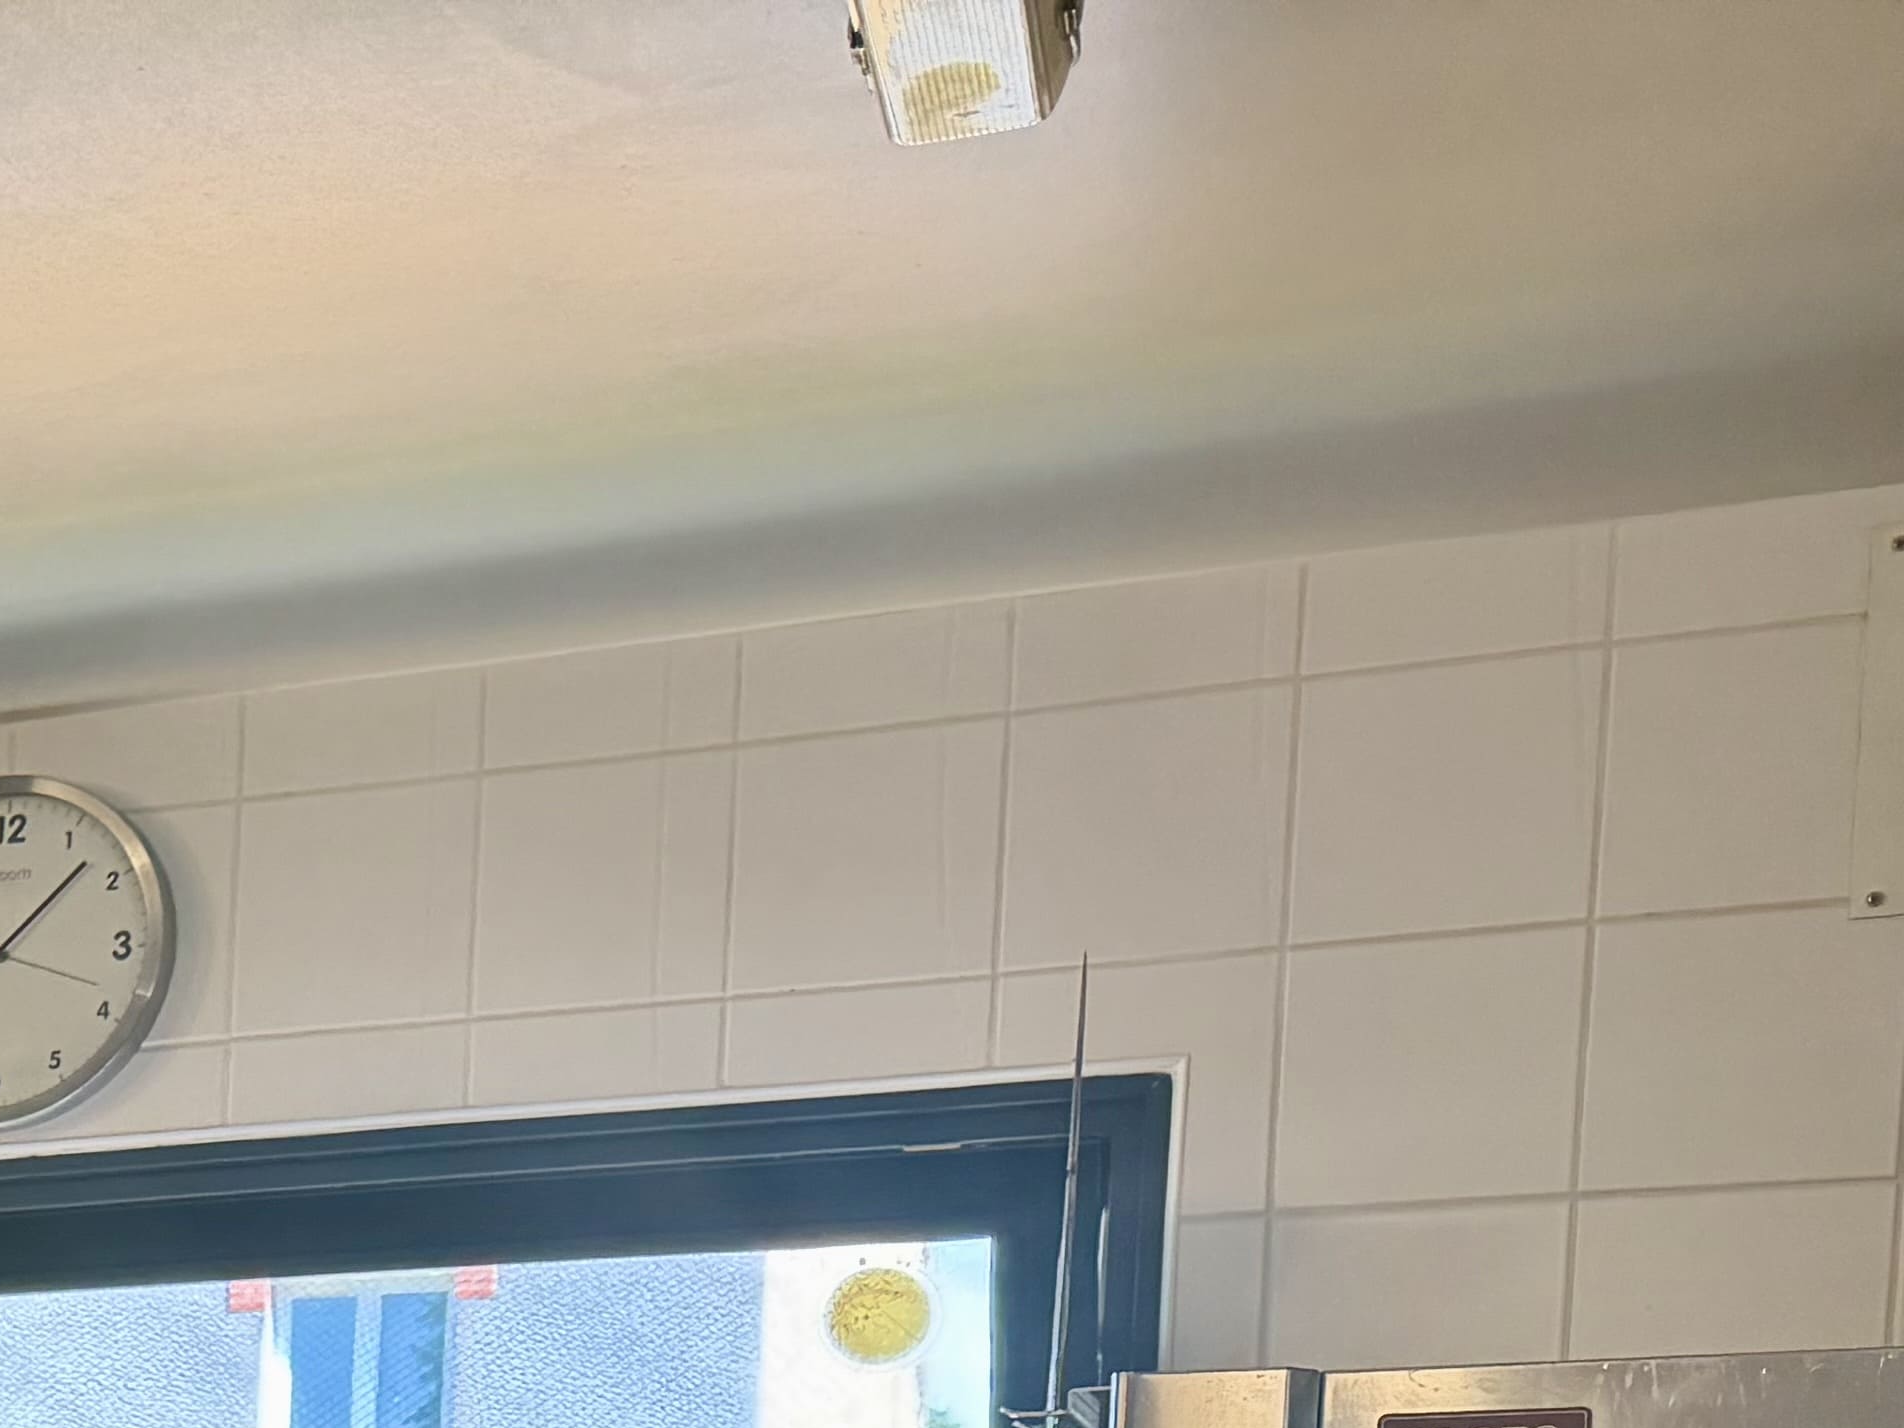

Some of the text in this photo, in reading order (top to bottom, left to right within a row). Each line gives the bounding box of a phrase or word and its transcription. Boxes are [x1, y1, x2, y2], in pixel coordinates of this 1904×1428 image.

[64, 831, 74, 850] 1
[105, 871, 120, 891] 2
[111, 930, 133, 961] 3
[96, 1001, 111, 1020] 4
[48, 1050, 62, 1070] 5
